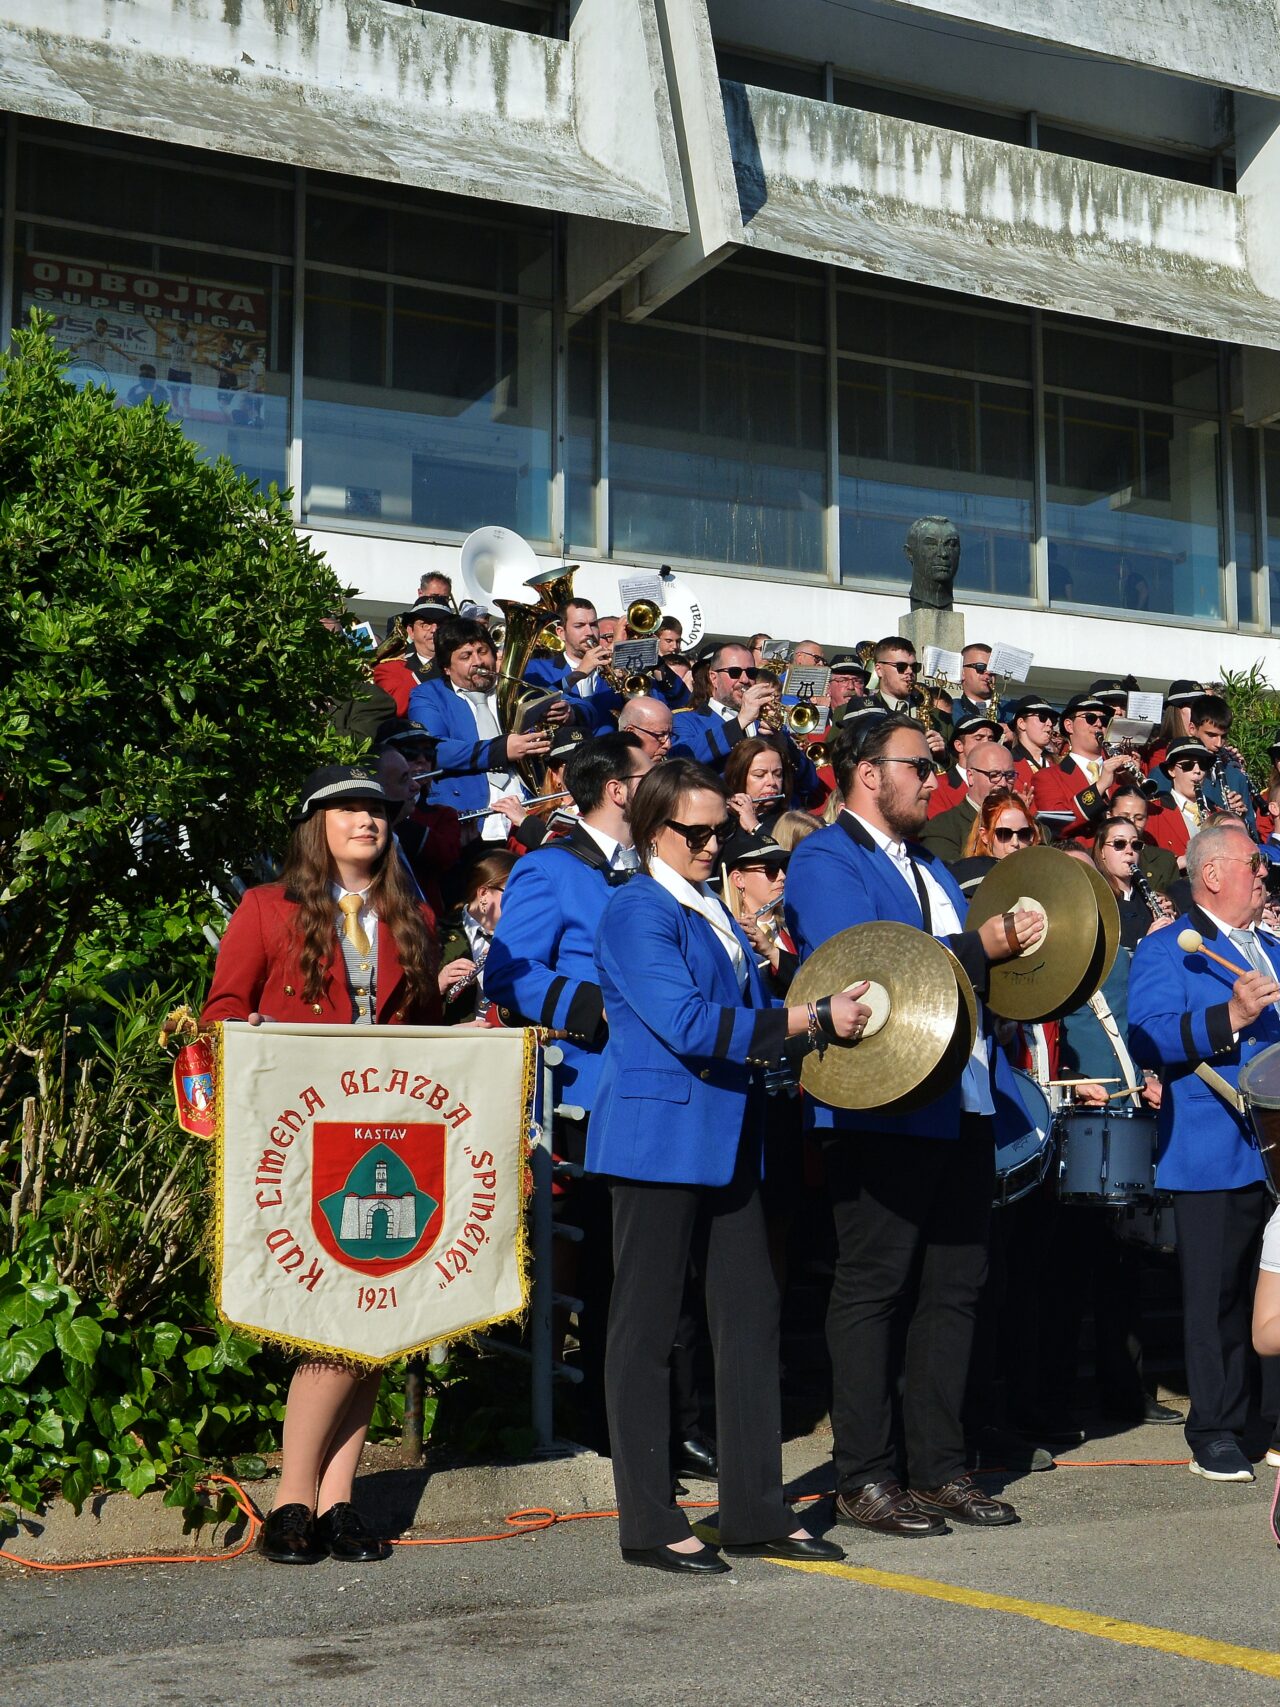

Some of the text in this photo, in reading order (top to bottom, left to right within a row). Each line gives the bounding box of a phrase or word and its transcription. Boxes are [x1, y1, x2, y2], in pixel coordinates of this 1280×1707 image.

[32, 262, 255, 314] ODBOJKA
[33, 288, 256, 333] SUPERLIGA
[681, 604, 701, 646] Lovran
[340, 1067, 473, 1130] GLAZBA
[255, 1085, 327, 1211] LIMENA
[354, 1127, 407, 1140] KASTAV
[265, 1228, 326, 1293] KUD
[356, 1286, 397, 1311] 1921
